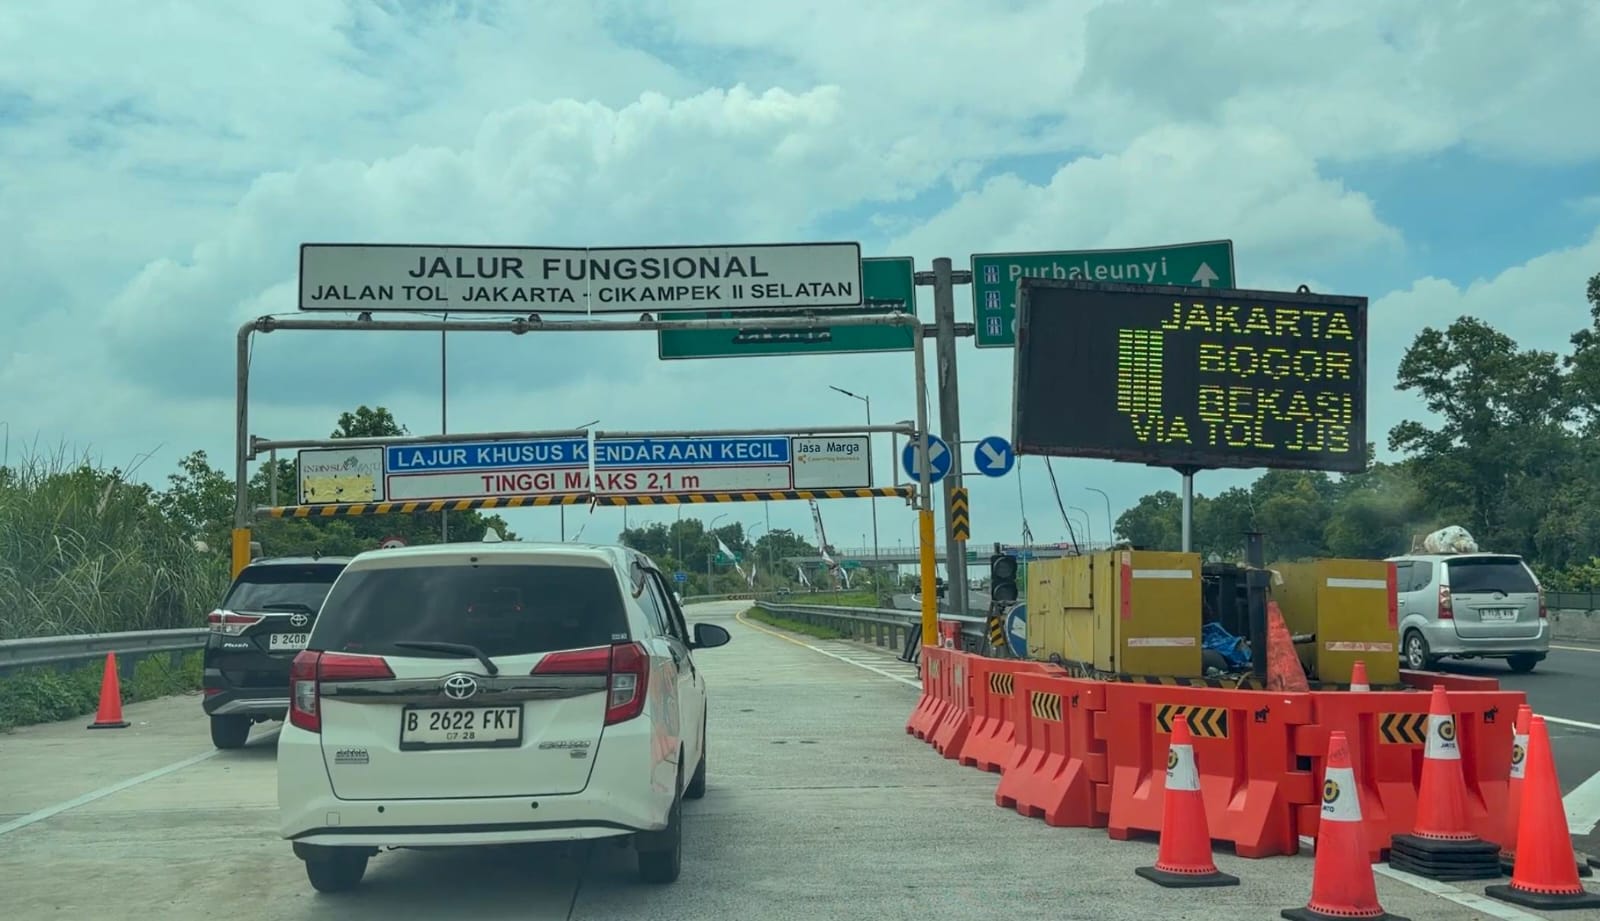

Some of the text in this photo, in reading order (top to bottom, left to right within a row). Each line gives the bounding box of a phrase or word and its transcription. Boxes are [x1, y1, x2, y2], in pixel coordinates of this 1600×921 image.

[408, 255, 769, 281] JALUR FUNGSIONAL
[1008, 256, 1168, 283] Purbaleunyi
[311, 285, 394, 301] JALAN
[402, 285, 449, 301] TOL
[462, 286, 576, 304] JAKARTA
[599, 284, 721, 303] CIKAMPEK
[732, 284, 743, 300] II
[751, 281, 852, 299] SELATAN
[1161, 302, 1353, 340] JAKARTA
[1199, 344, 1352, 382] BOGOR
[1198, 384, 1352, 424] BEKASI
[1129, 413, 1350, 452] VIA TOL JJS
[397, 441, 780, 468] LAJUR KHUSUS KENDARAAN KECIL
[797, 441, 860, 455] Jasa Marga
[481, 473, 556, 493] TINGGI
[565, 471, 637, 490] MAKS
[682, 473, 700, 489] m
[271, 634, 278, 645] B
[407, 709, 518, 731] B 2622 FKT
[462, 731, 475, 740] 28
